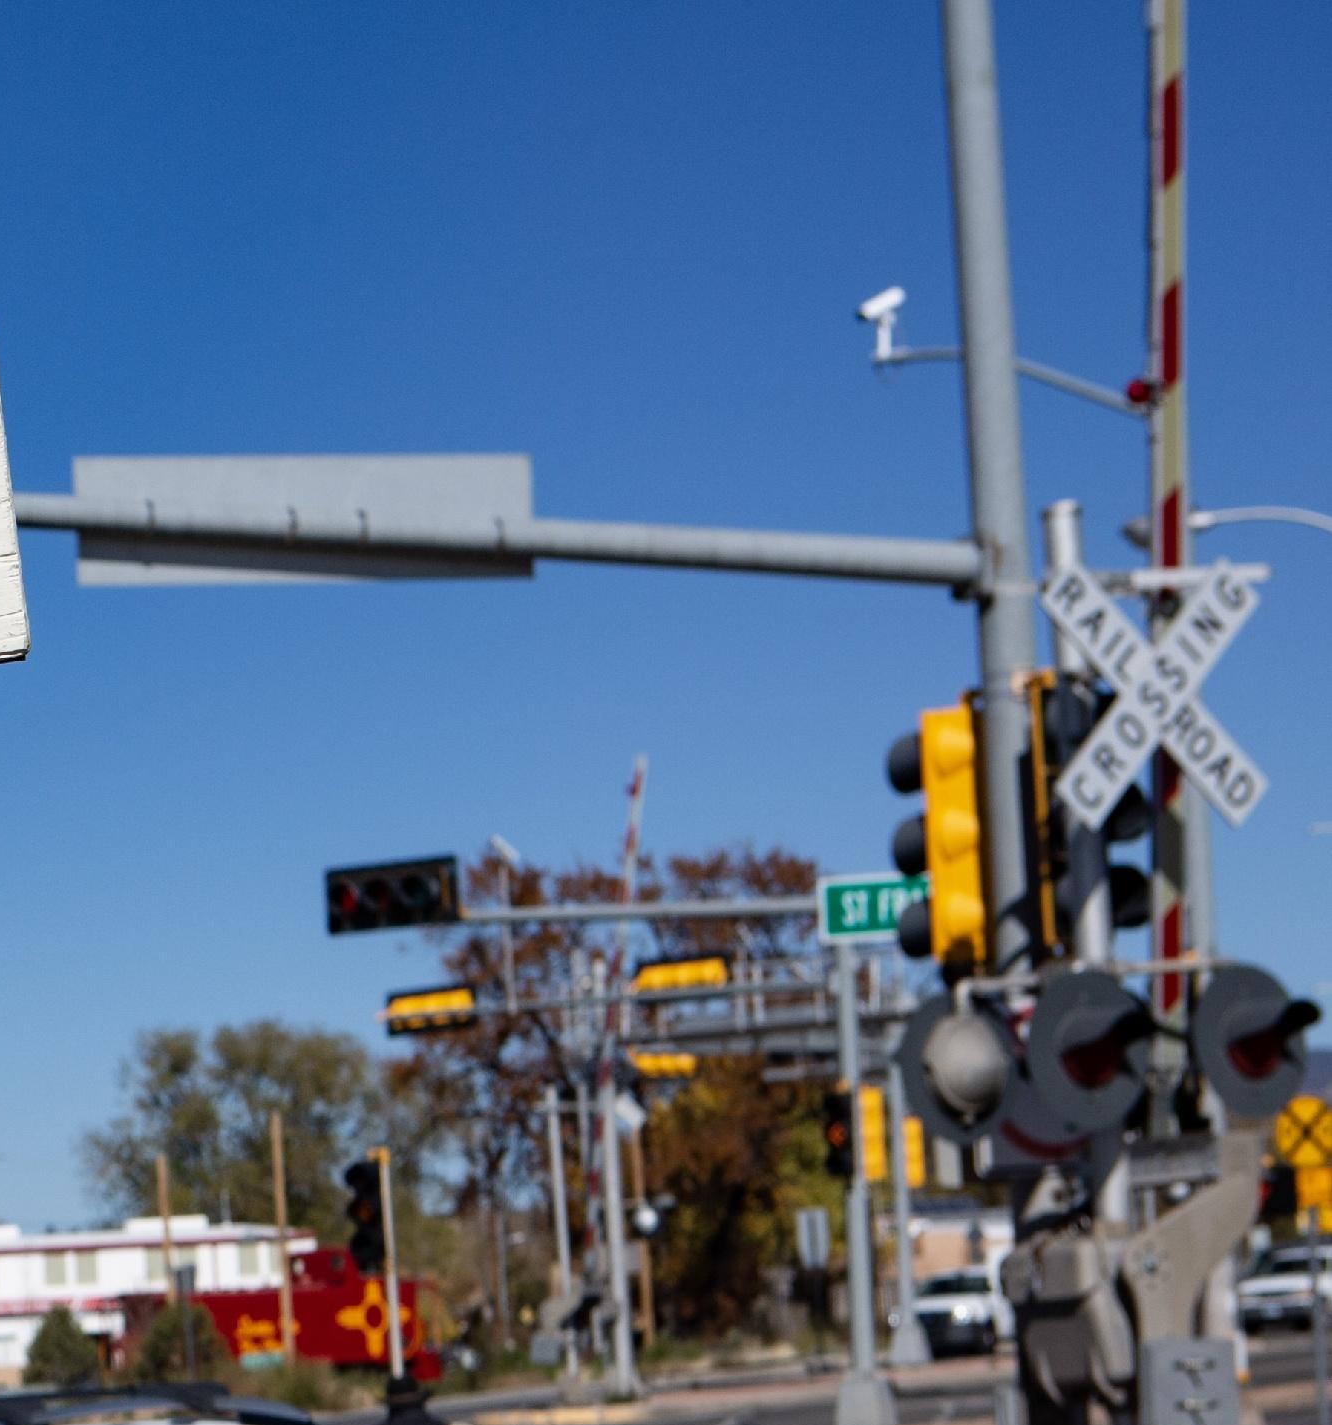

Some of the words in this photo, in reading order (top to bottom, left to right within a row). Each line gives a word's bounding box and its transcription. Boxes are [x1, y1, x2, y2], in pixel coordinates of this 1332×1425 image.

[1054, 572, 1136, 685] RAIL
[1070, 573, 1248, 811] CROSSING
[842, 889, 869, 926] ST
